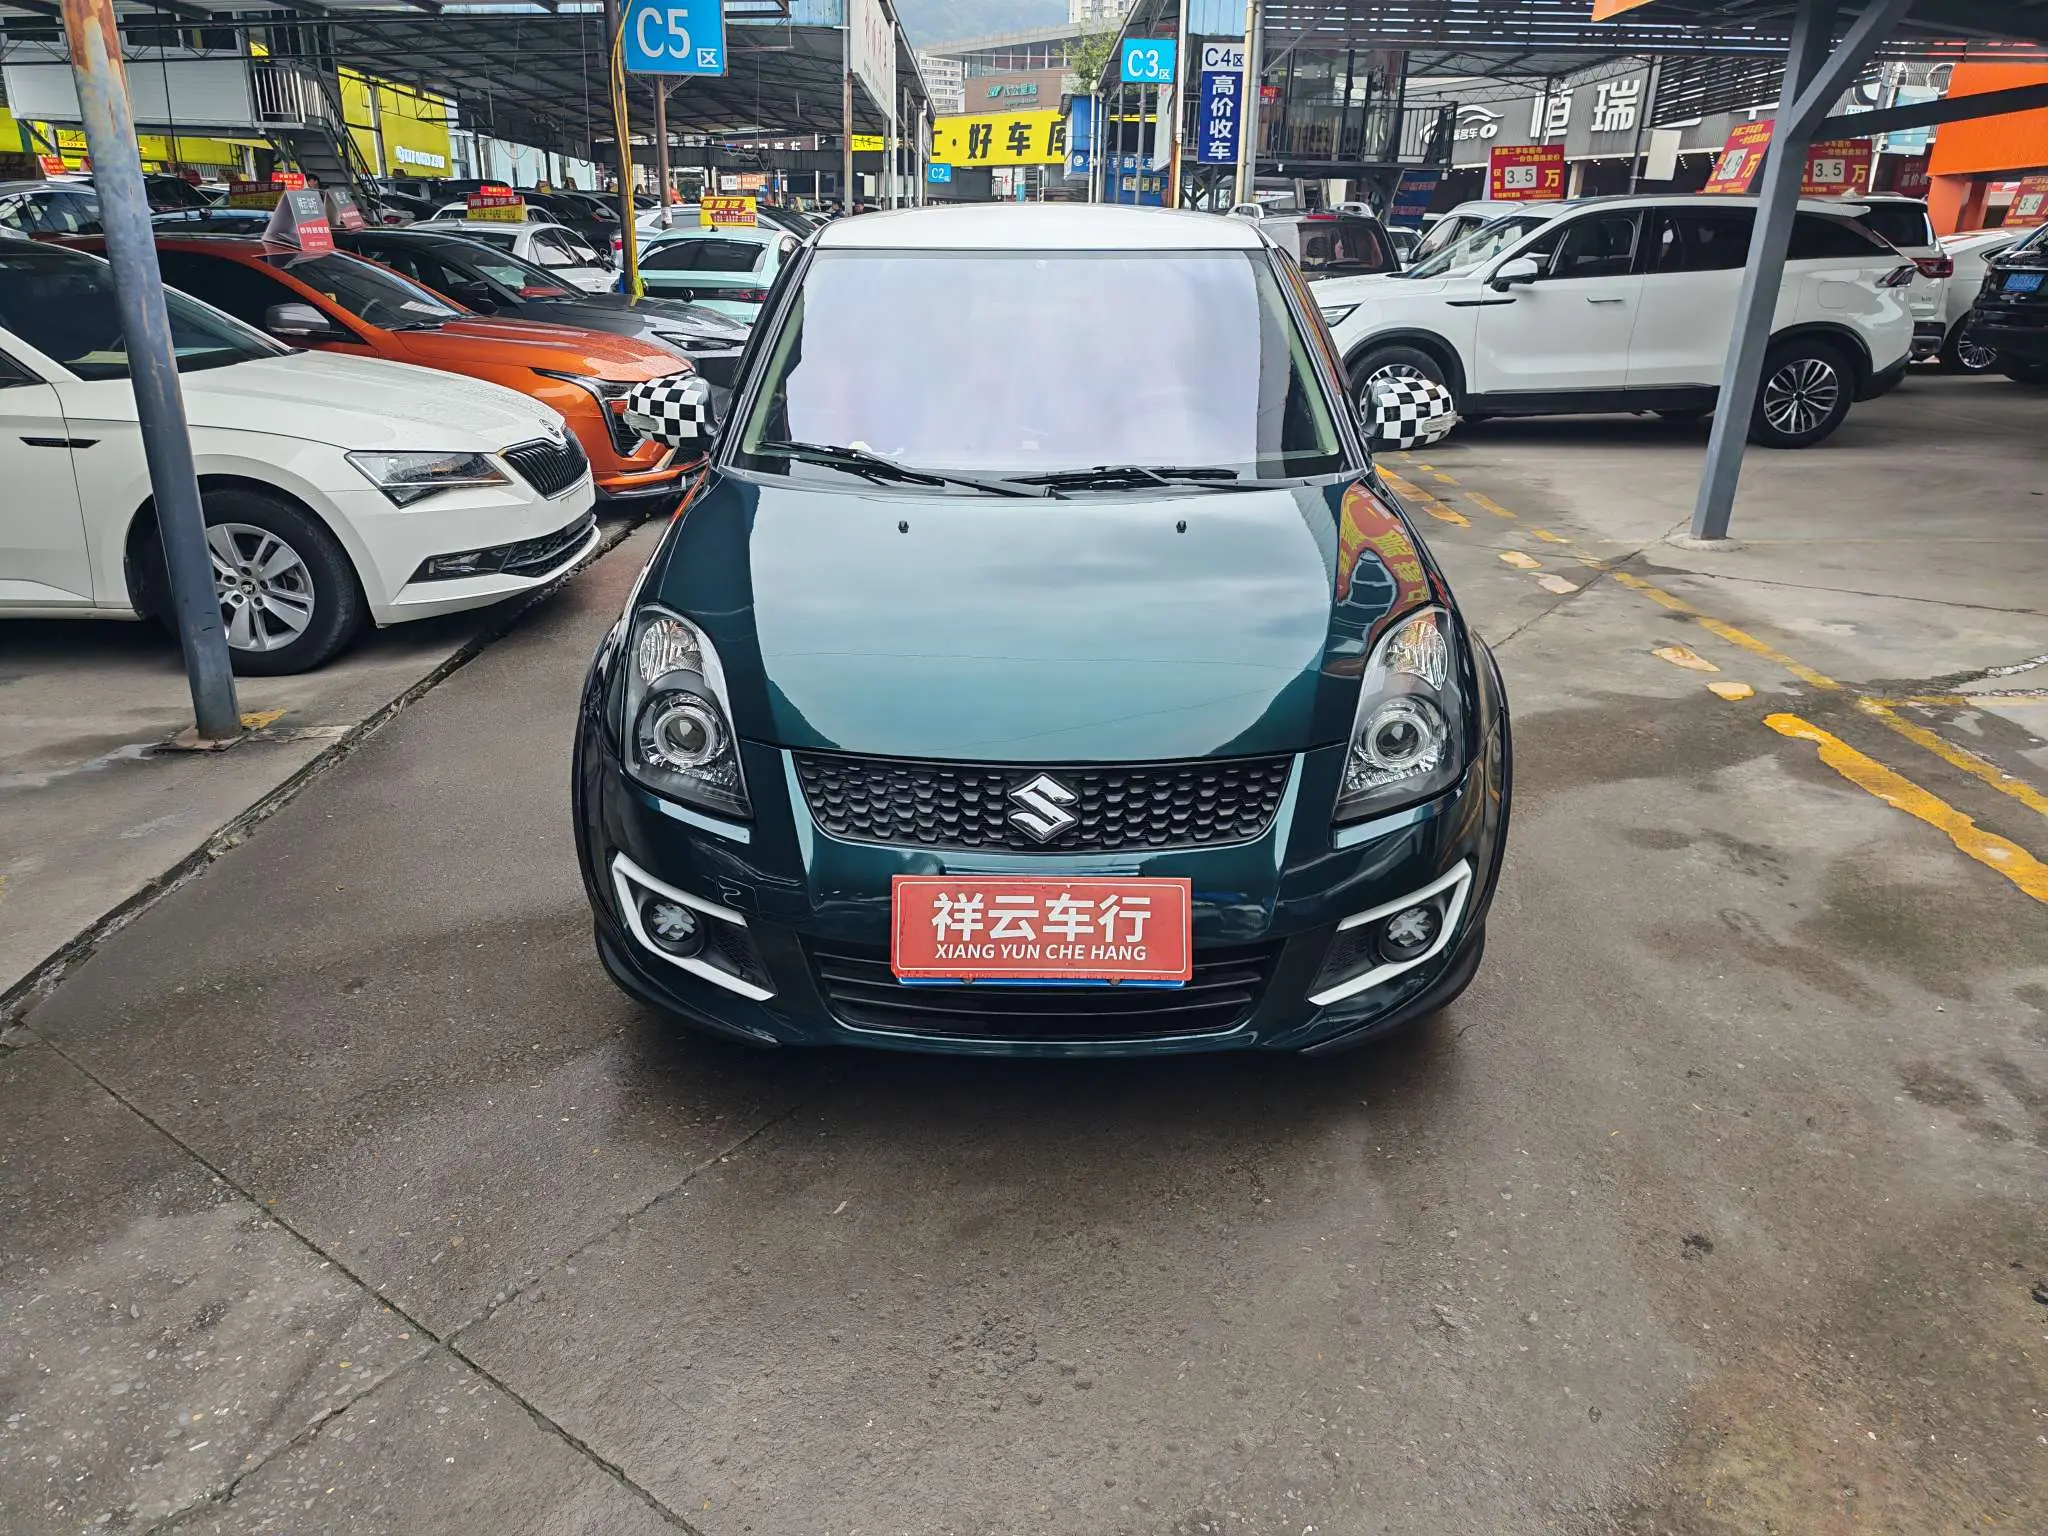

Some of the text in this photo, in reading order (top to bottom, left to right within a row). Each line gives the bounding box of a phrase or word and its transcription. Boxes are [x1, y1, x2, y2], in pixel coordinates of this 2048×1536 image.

[637, 7, 719, 68] C5区
[1127, 49, 1170, 79] C3区
[1208, 75, 1236, 160] 高价收车
[1507, 169, 1560, 187] 3.5 万
[1815, 162, 1868, 183] 3.5 万
[932, 893, 1151, 943] 祥云车行
[935, 943, 1147, 961] XIANG YUN CHE HANG
